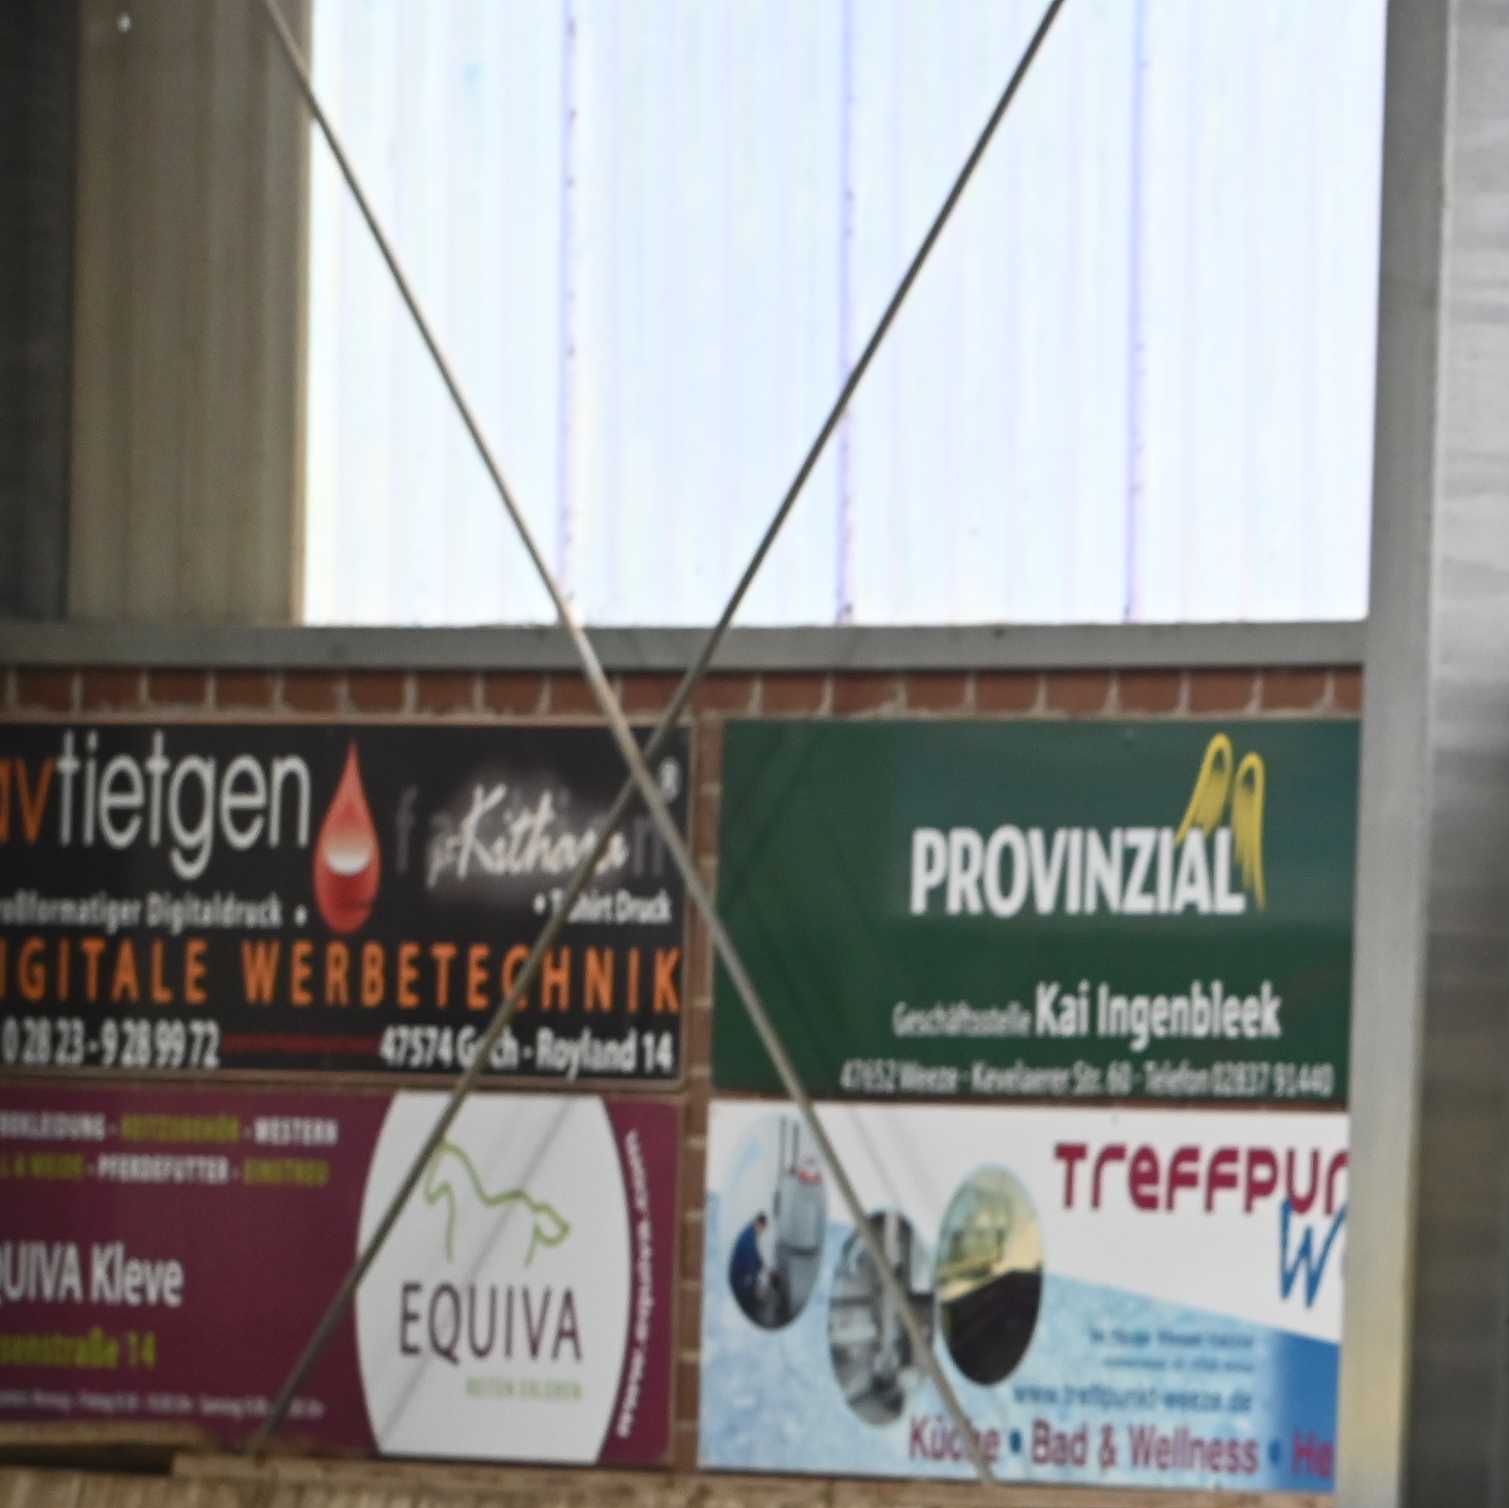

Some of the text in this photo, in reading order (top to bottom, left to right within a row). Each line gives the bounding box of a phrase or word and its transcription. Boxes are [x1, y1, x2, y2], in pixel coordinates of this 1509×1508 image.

[910, 825, 1247, 917] PROVINZIAL
[242, 940, 683, 1014] WERBETECHNIK
[643, 1031, 673, 1073] 14
[1035, 981, 1089, 1038] Kai
[1097, 980, 1282, 1052] Ingenbleek
[91, 1241, 185, 1307] Kleve
[400, 1281, 583, 1365] EQUIVA
[1030, 1418, 1089, 1468] Bad
[1099, 1423, 1118, 1471] &
[1128, 1425, 1259, 1474] Wellness
